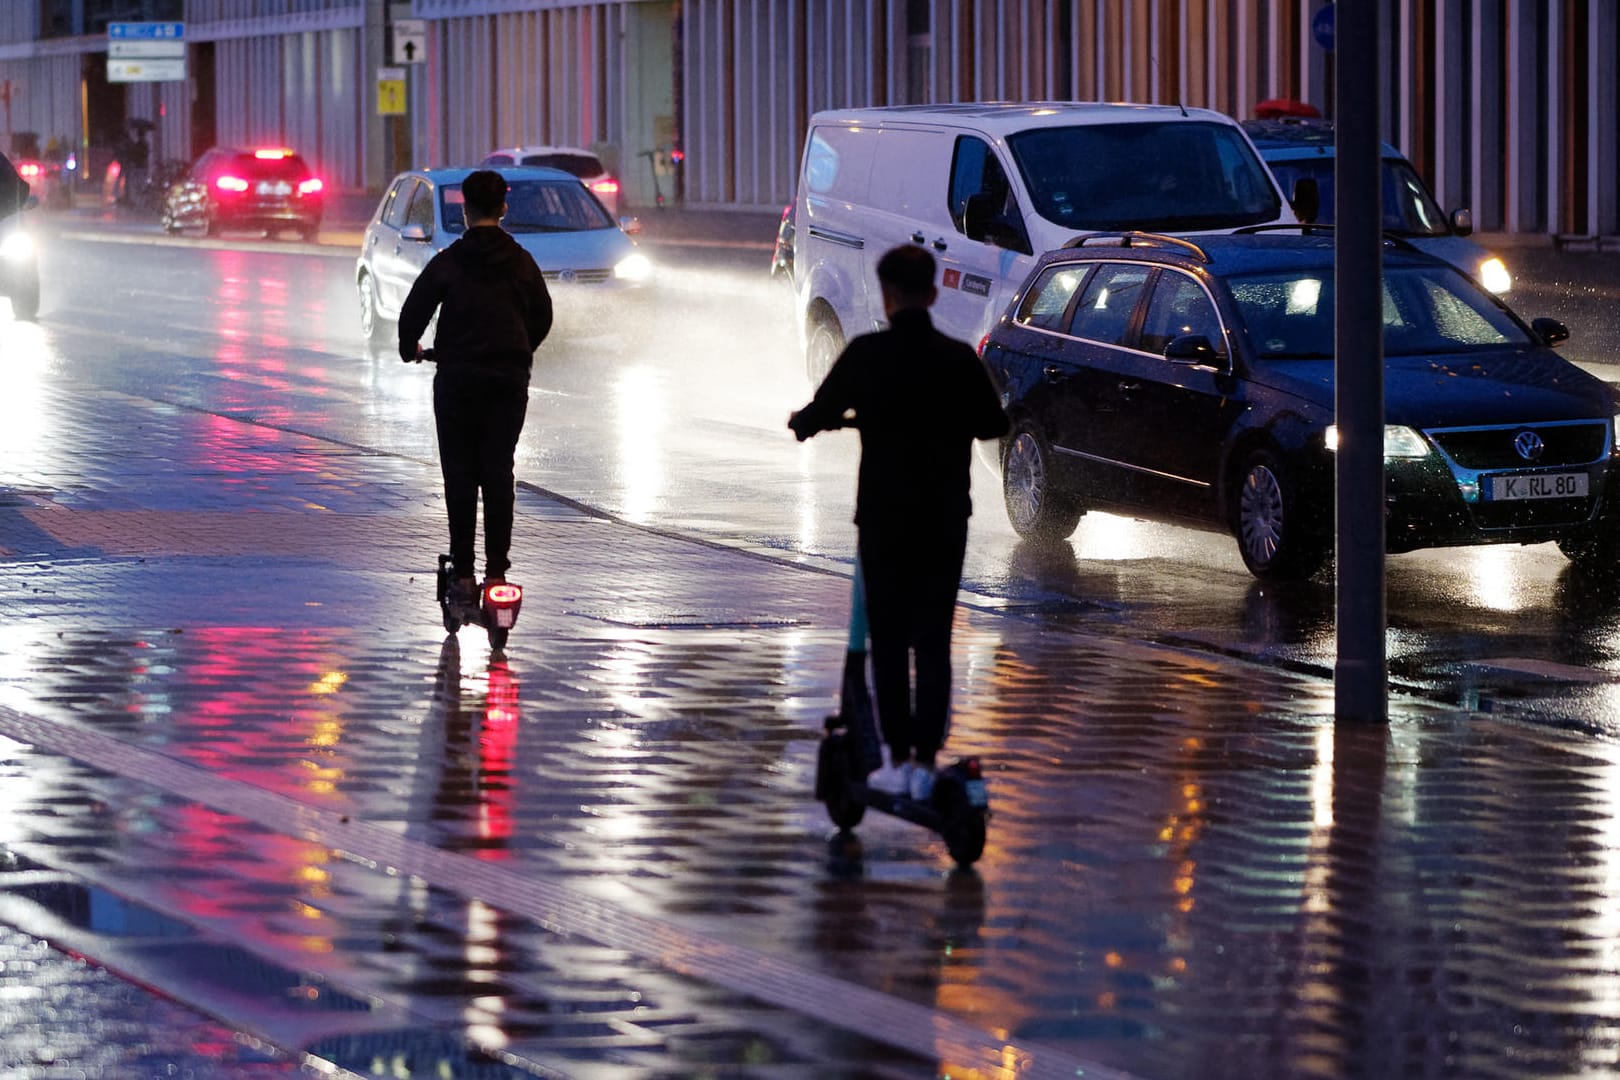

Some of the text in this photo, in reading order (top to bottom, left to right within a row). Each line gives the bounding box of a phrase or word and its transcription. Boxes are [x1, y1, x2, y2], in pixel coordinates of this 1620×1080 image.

[1505, 476, 1576, 497] K RL 80
